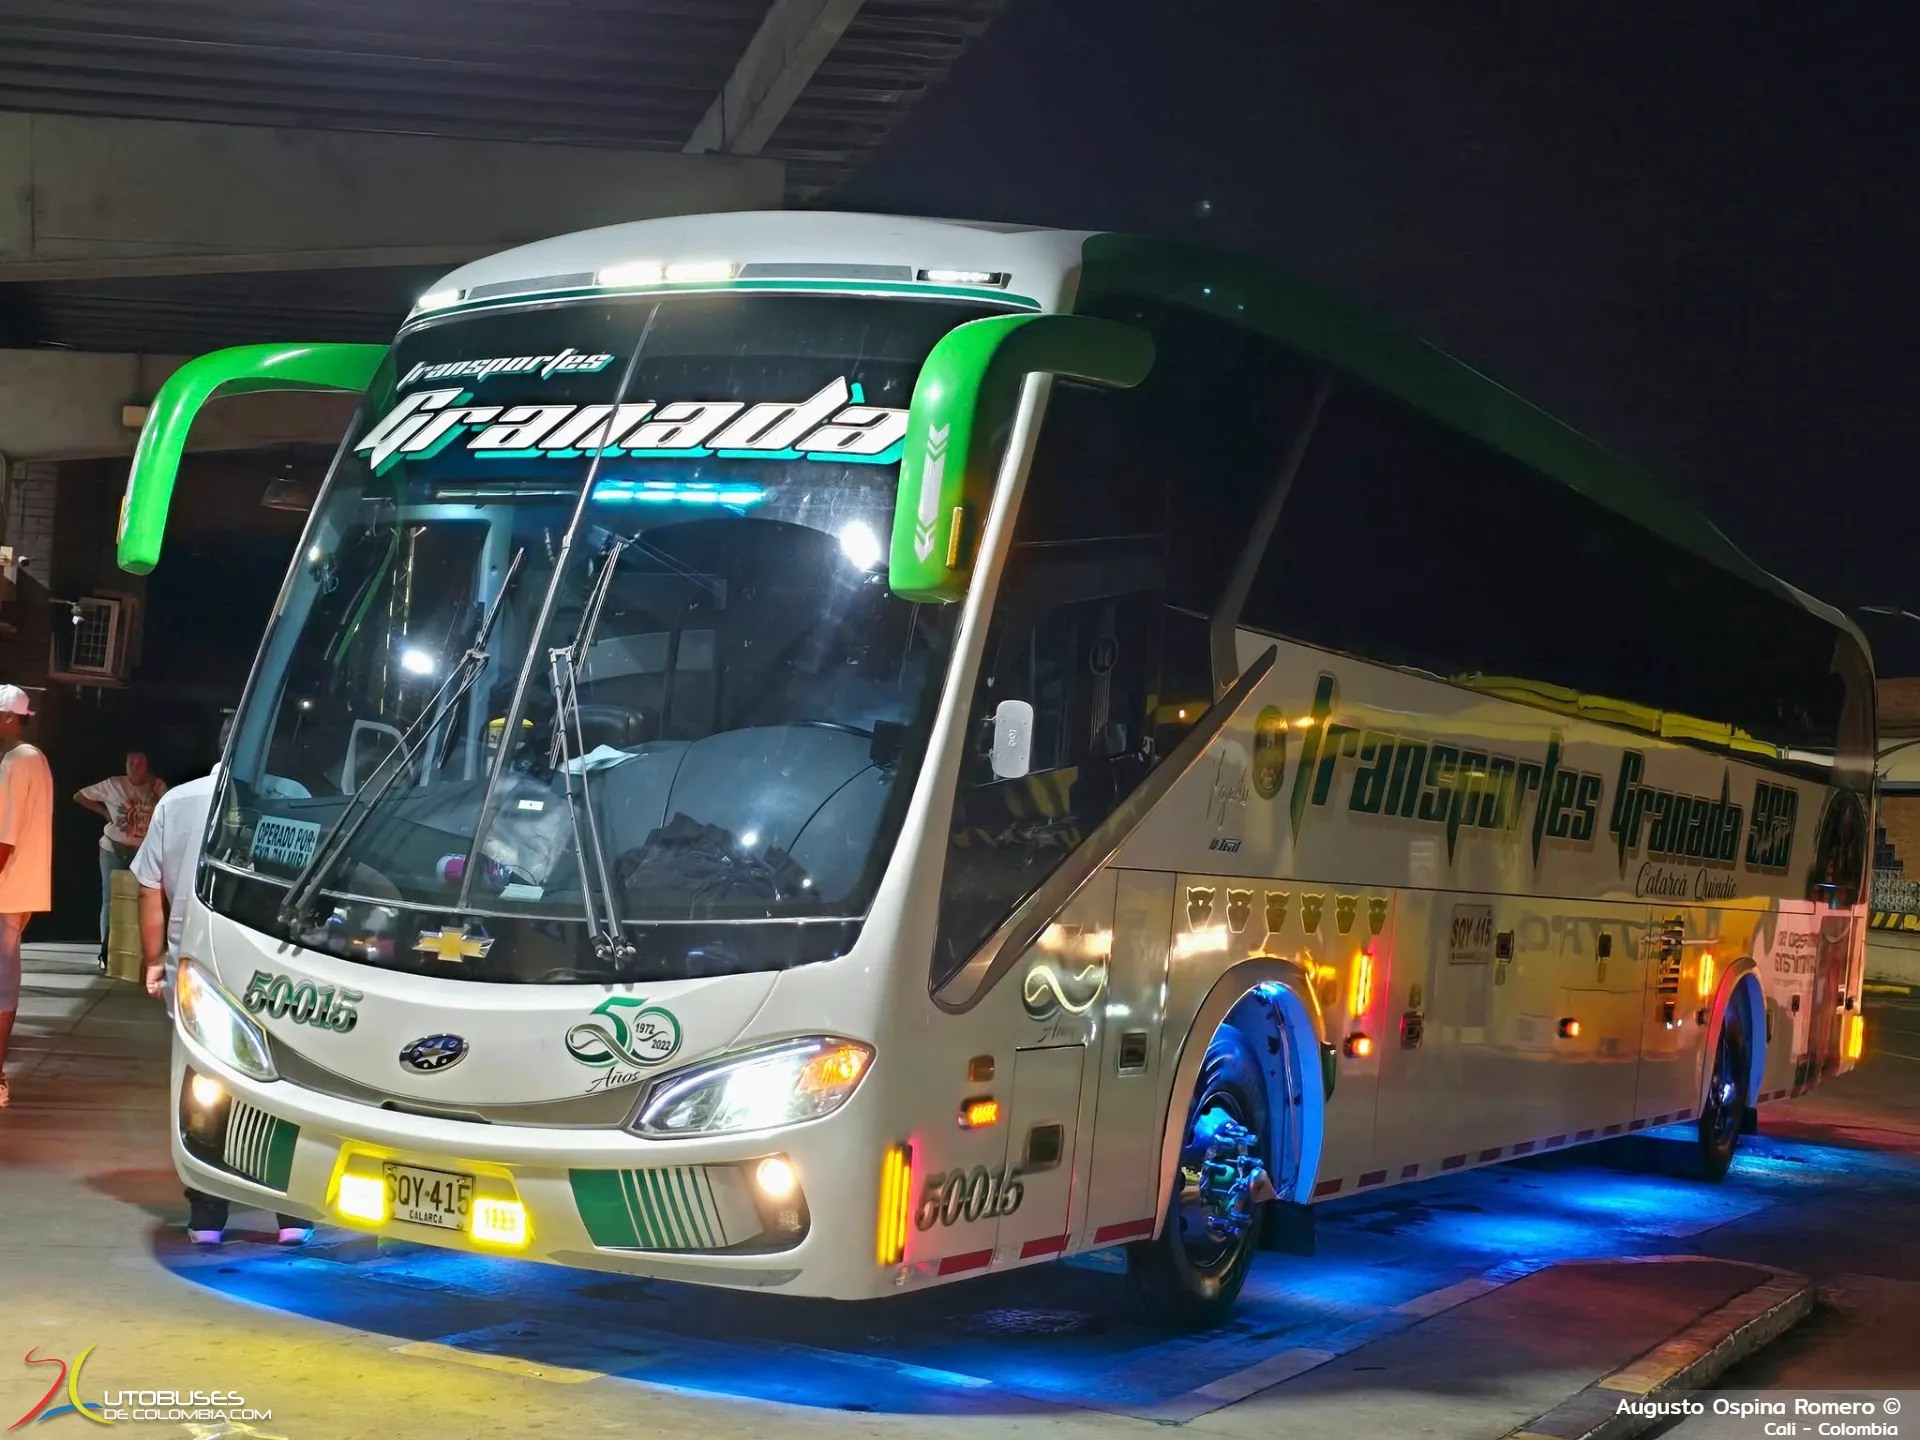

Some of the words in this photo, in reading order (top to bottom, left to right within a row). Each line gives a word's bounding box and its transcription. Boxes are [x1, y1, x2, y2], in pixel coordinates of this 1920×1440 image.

[354, 376, 909, 474] Granada
[1610, 749, 1743, 881] Granada
[257, 822, 296, 849] OPERADO
[294, 828, 316, 853] POR:
[242, 969, 364, 1034] 50015
[635, 1023, 656, 1035] 1972
[651, 1039, 672, 1051] 2022
[585, 1066, 640, 1092] Años
[915, 1164, 1025, 1232] 50015
[409, 1209, 443, 1225] CALARCA
